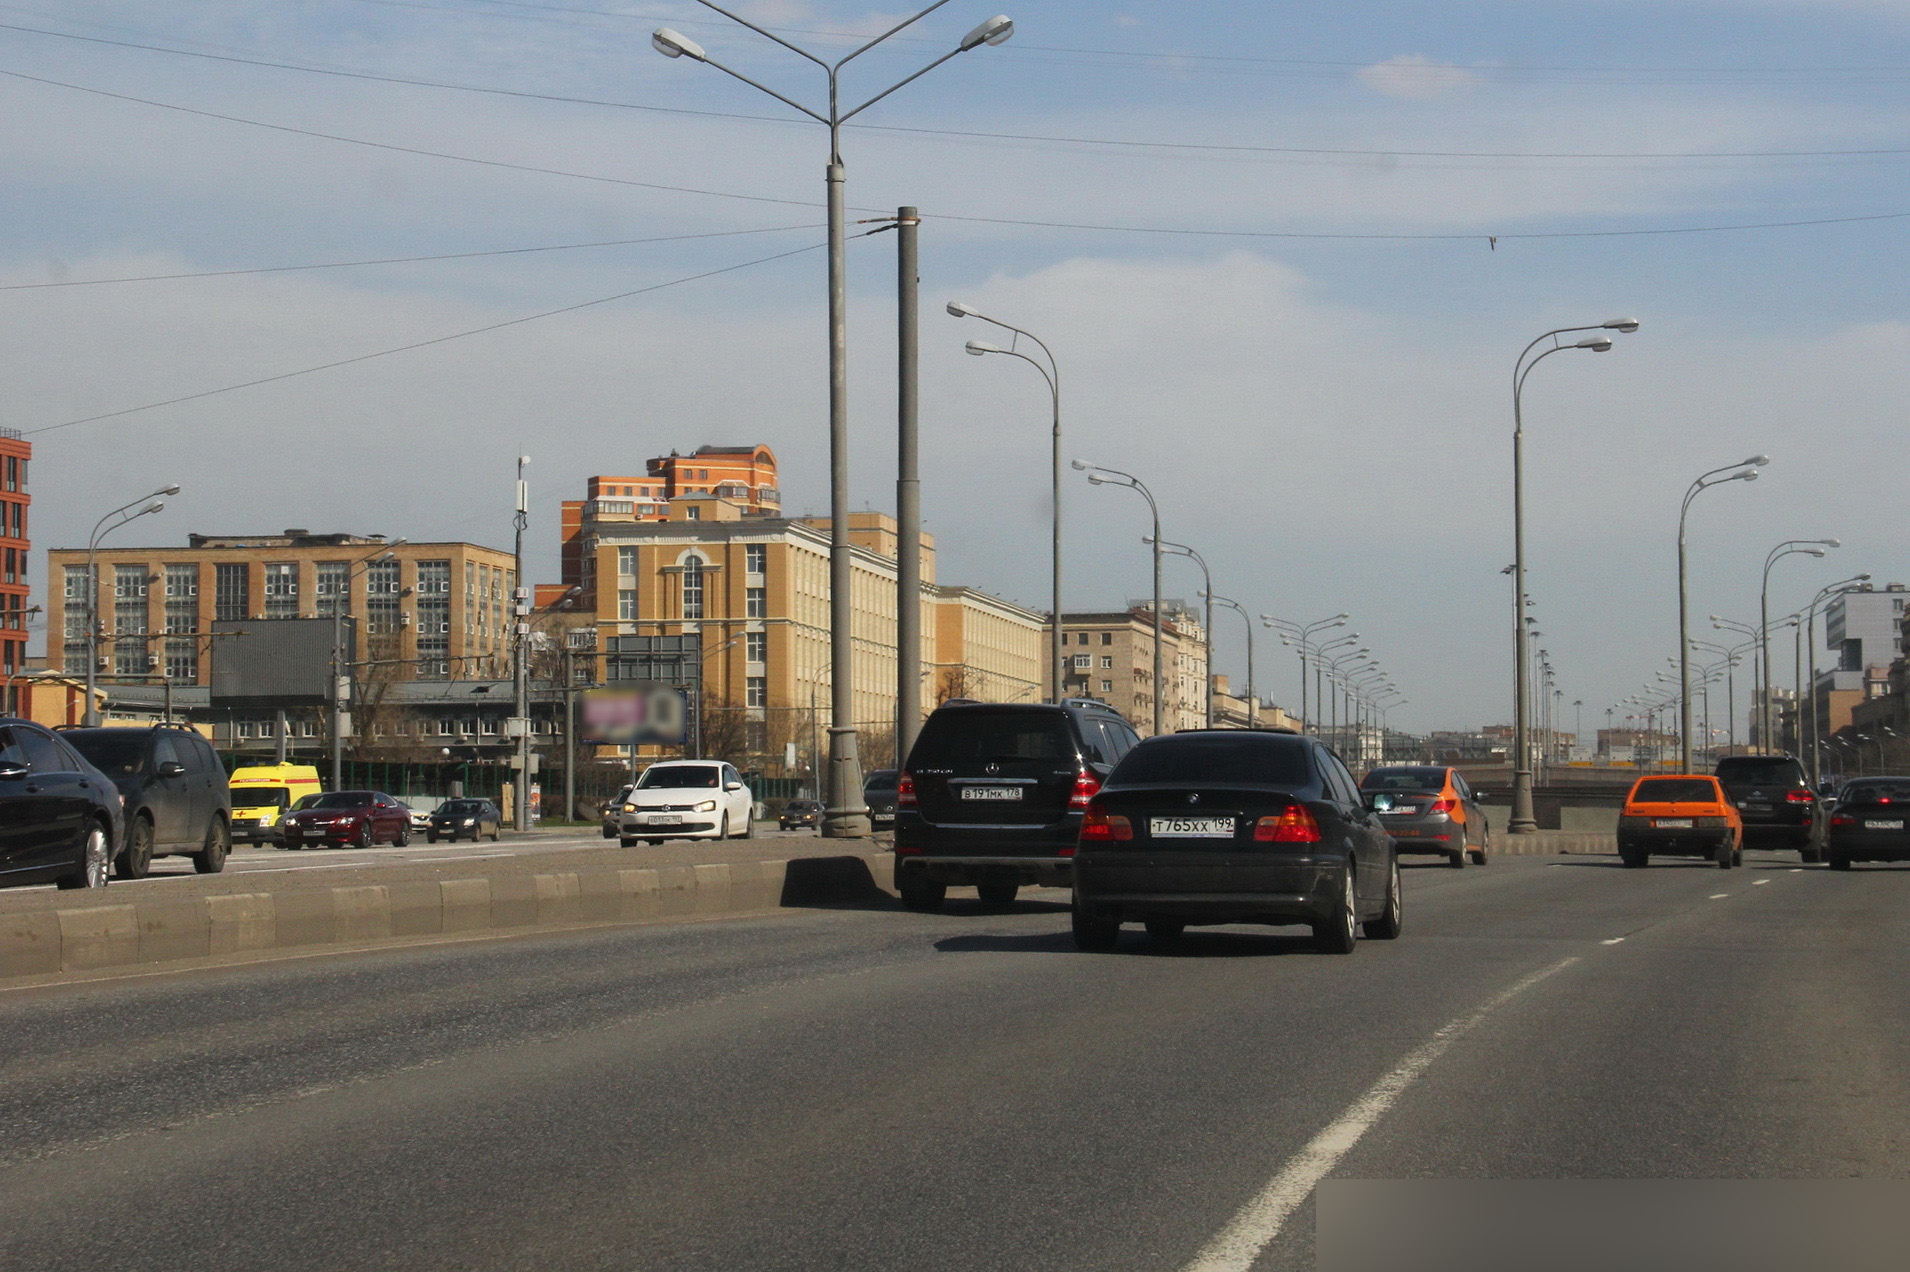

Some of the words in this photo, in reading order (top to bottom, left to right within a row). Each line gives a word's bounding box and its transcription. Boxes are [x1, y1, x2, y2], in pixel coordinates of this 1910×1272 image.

[1005, 787, 1020, 797] 178
[1156, 818, 1208, 832] Т765ХХ
[1212, 817, 1232, 829] 199
